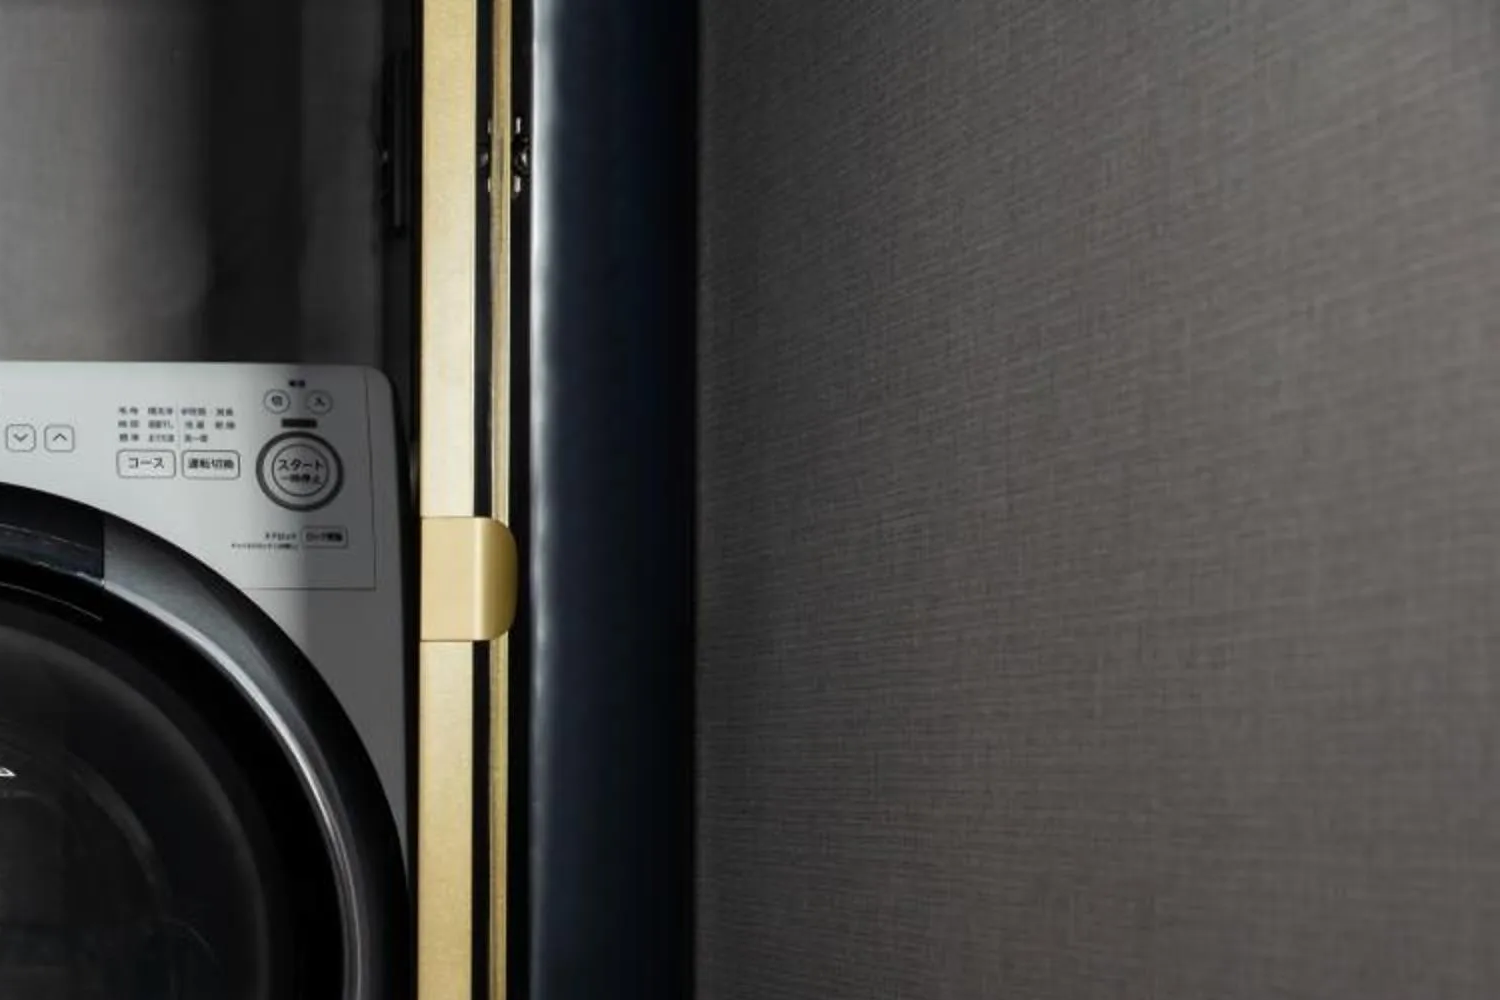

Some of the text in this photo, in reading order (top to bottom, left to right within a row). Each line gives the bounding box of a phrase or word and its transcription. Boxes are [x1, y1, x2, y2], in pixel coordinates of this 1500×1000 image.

[128, 457, 165, 469] コース
[278, 458, 324, 472] スタート
